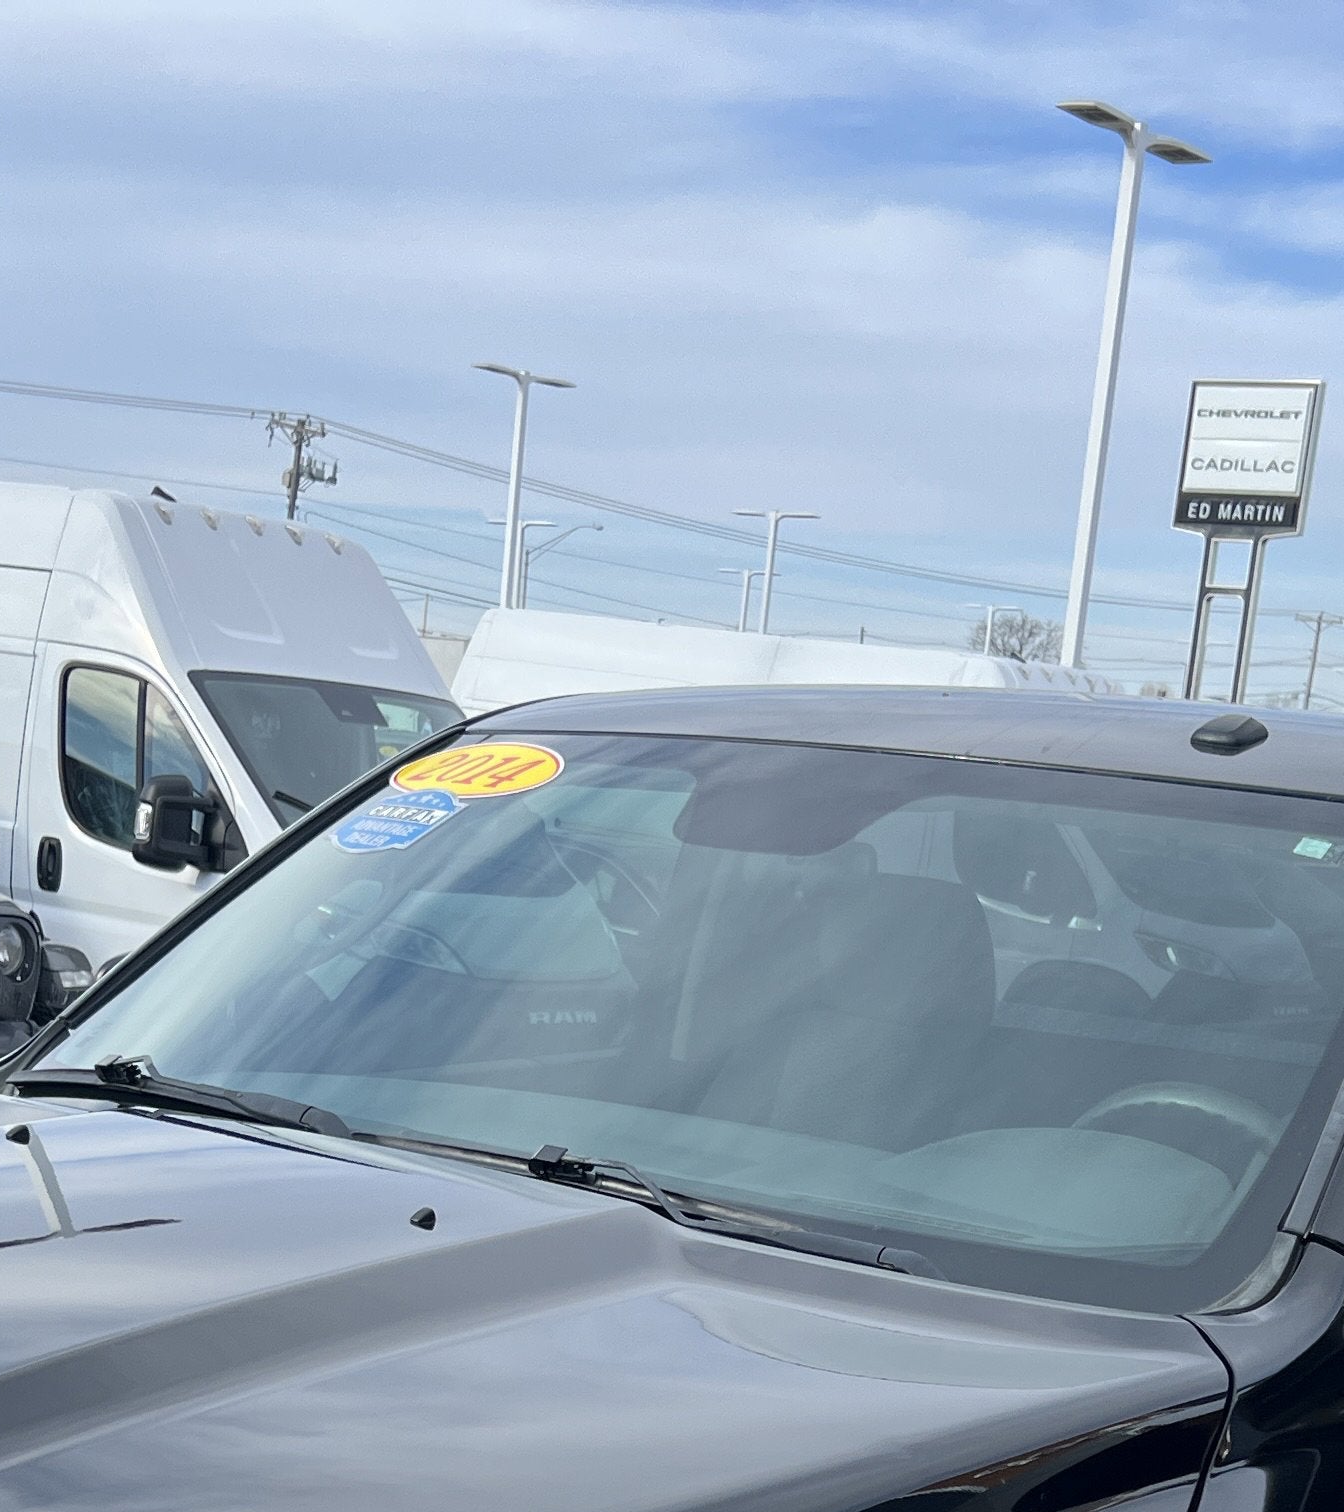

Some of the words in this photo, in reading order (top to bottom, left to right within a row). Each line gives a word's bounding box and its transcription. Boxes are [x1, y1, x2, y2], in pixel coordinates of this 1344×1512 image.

[1196, 408, 1303, 421] CHEVROLET
[1190, 457, 1296, 474] CADILLAC
[1186, 502, 1211, 520] ED
[1217, 502, 1286, 523] MARTIN
[405, 753, 548, 789] 2014
[369, 806, 450, 825] CARFAX
[529, 1011, 597, 1025] RAM
